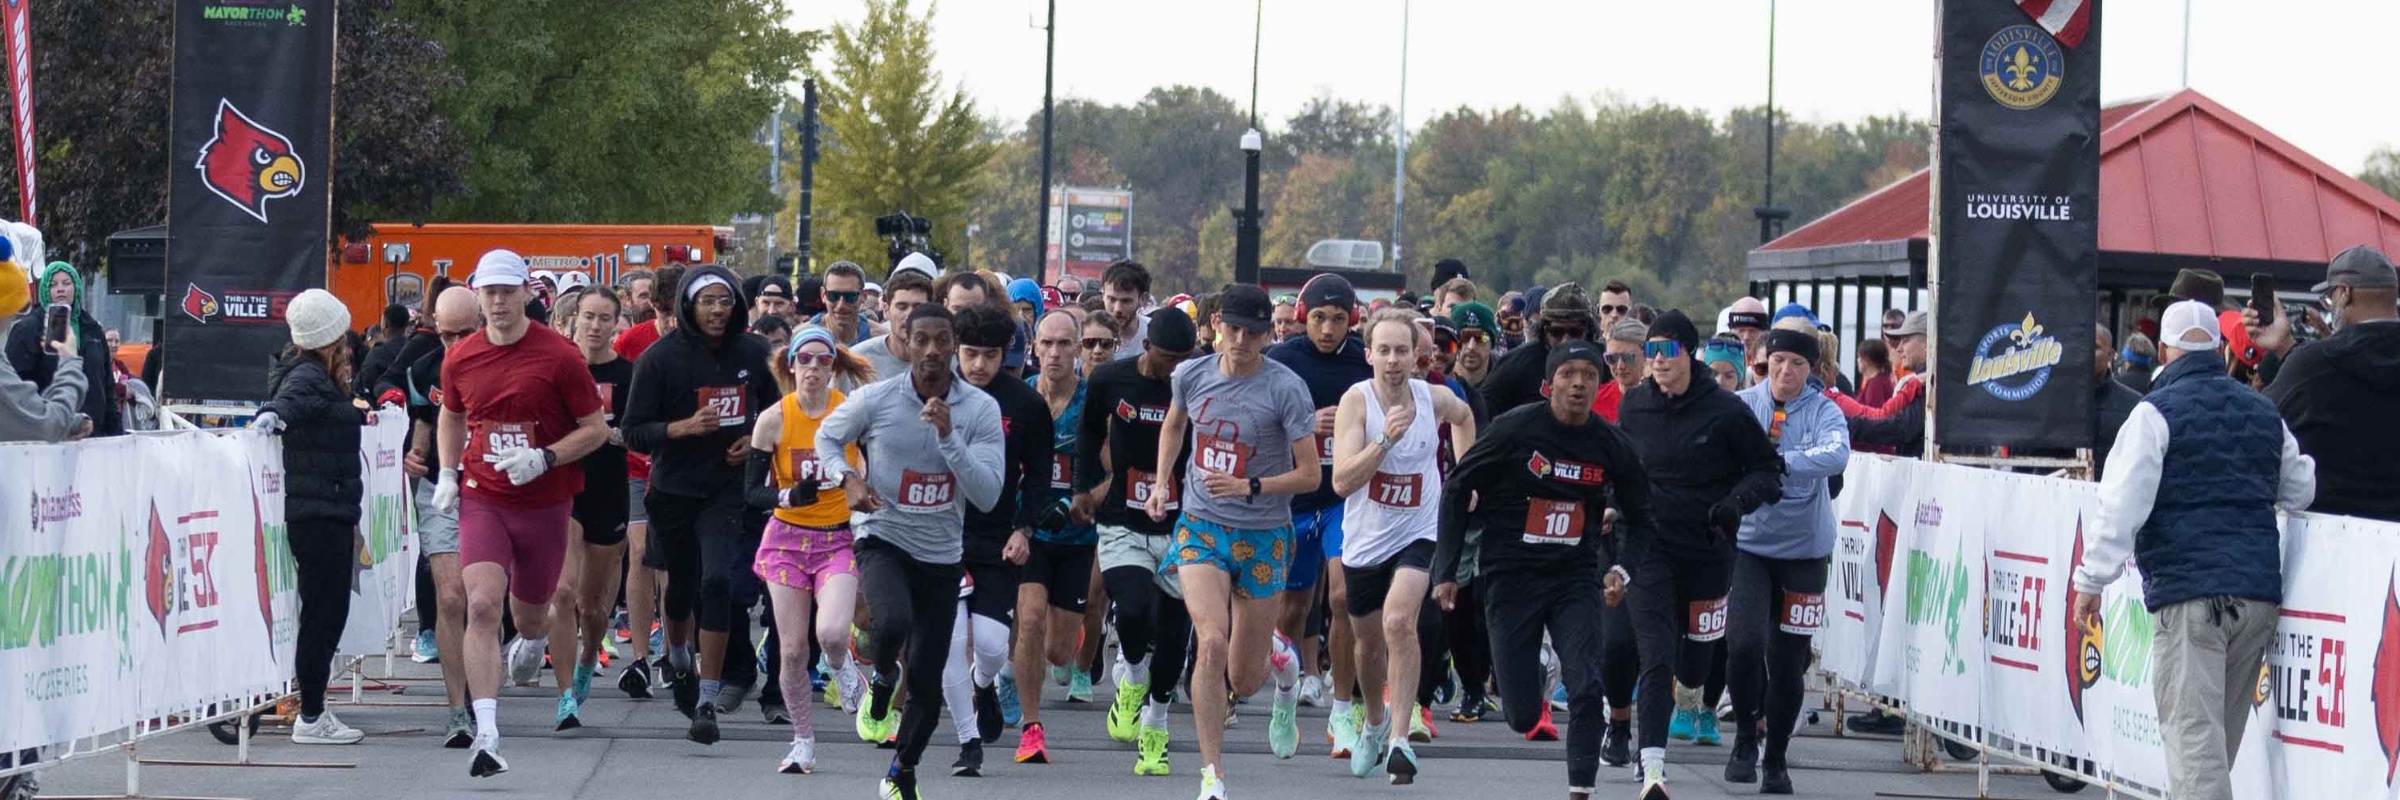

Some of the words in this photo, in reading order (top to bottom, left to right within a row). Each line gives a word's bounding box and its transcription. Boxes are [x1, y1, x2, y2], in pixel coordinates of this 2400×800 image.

[203, 5, 285, 19] MAYORTHON
[1986, 29, 2058, 58] LOUISVILLE
[1967, 194, 2048, 204] UNIVERSITY
[2055, 196, 2070, 205] OF
[1967, 203, 2070, 220] LOUISVILLE
[532, 257, 580, 269] METRO
[592, 254, 619, 286] 11
[224, 295, 248, 303] THRU
[224, 304, 267, 317] VILLE
[271, 297, 287, 317] 5
[1981, 327, 2010, 352] SPORTS
[1967, 336, 2062, 386] Louisville
[1988, 370, 2049, 398] COMMISSION
[1140, 412, 1165, 422] VILLE
[489, 433, 530, 454] 935
[801, 460, 824, 481] 87
[1203, 446, 1238, 475] 647
[1554, 467, 1580, 480] VILLE
[1582, 467, 1604, 482] 5K
[908, 483, 950, 504] 684
[1380, 483, 1412, 505] 774
[1545, 513, 1570, 536] 10
[188, 530, 218, 609] 5K
[2007, 571, 2019, 593] THE
[1789, 603, 1823, 626] 963
[1992, 597, 2016, 647] VILLE
[2290, 633, 2313, 658] THE
[2316, 637, 2346, 729] 5K
